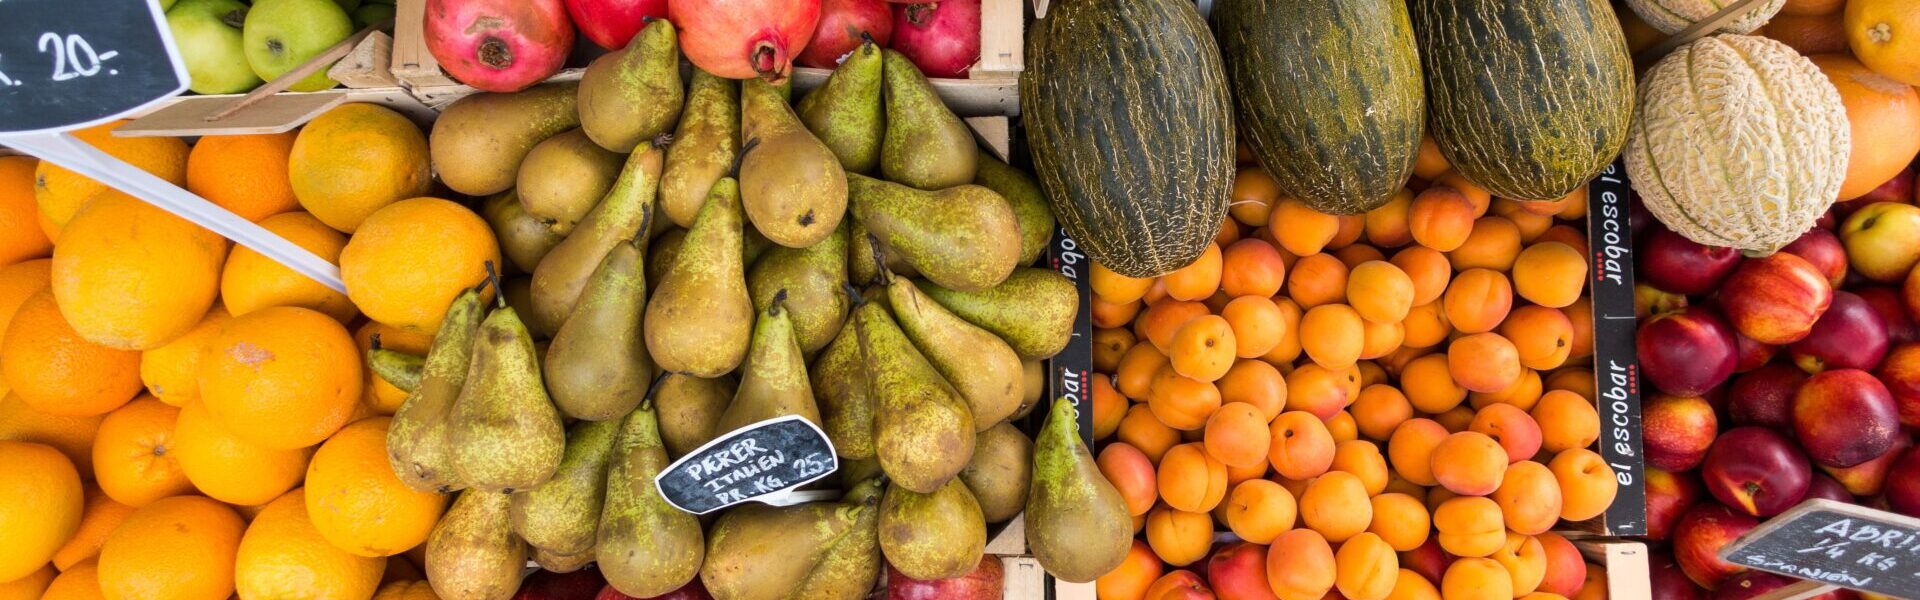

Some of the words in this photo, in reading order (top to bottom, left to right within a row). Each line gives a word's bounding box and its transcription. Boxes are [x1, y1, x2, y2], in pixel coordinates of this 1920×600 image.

[1601, 191, 1629, 286] escobar
[1602, 359, 1634, 457] escobar
[703, 449, 785, 493] ITALIEN
[1610, 462, 1633, 486] el
